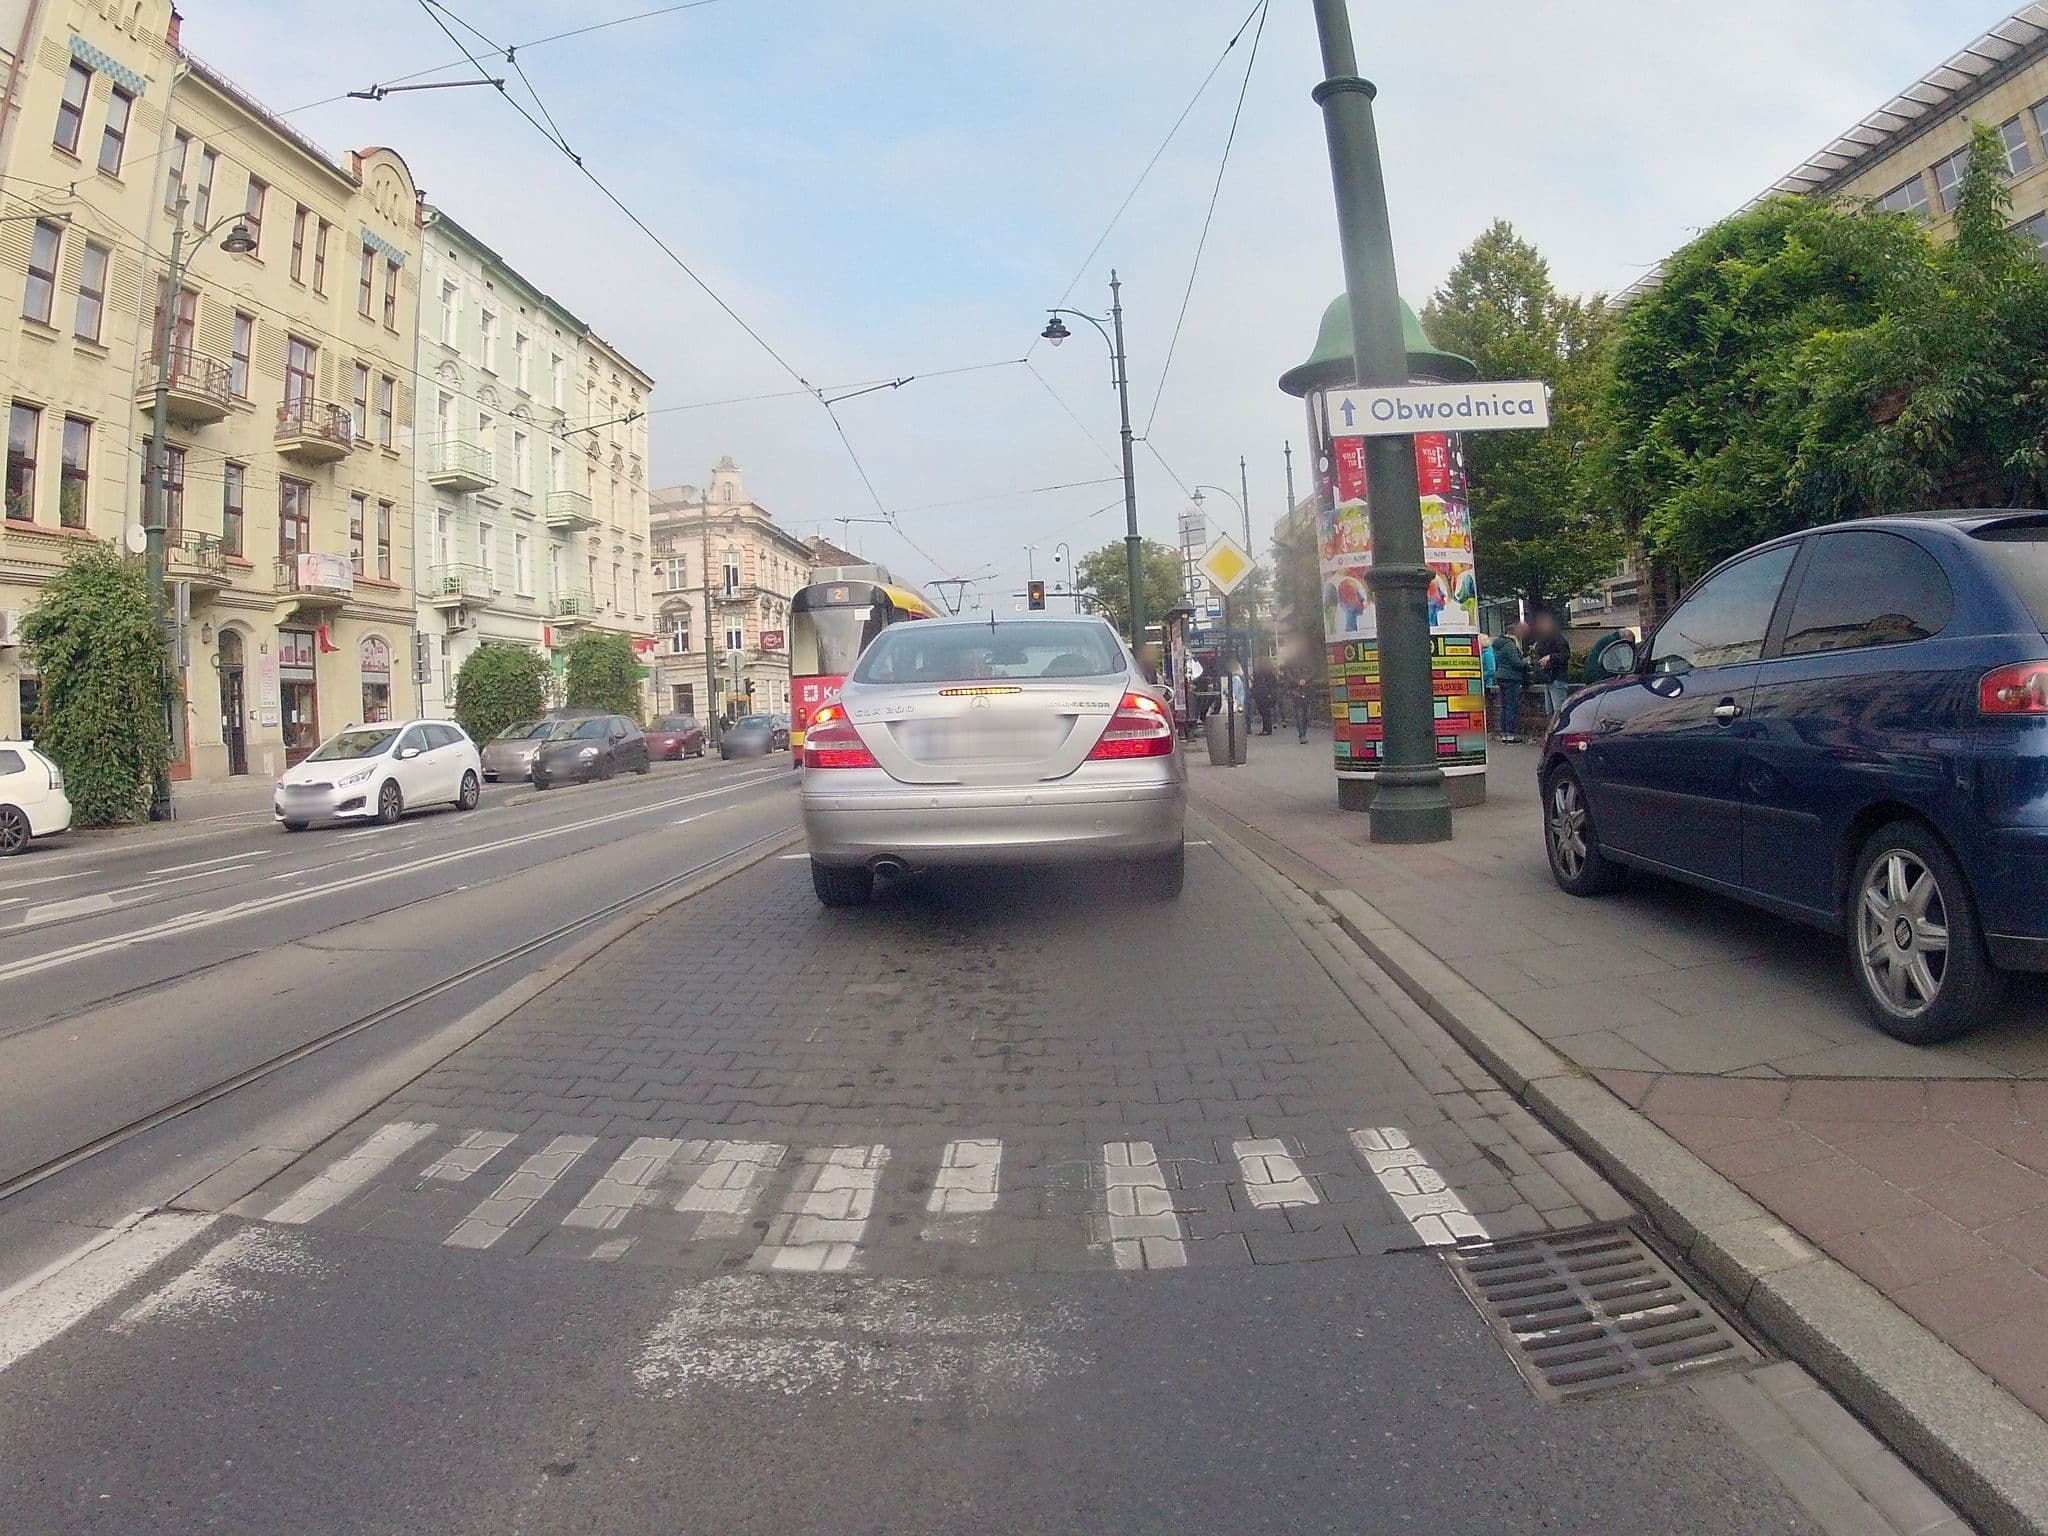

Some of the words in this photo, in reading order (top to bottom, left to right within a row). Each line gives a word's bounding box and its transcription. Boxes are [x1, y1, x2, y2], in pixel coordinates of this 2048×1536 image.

[1371, 394, 1534, 421] Obwodnica
[834, 588, 842, 601] 2
[885, 704, 915, 714] 200
